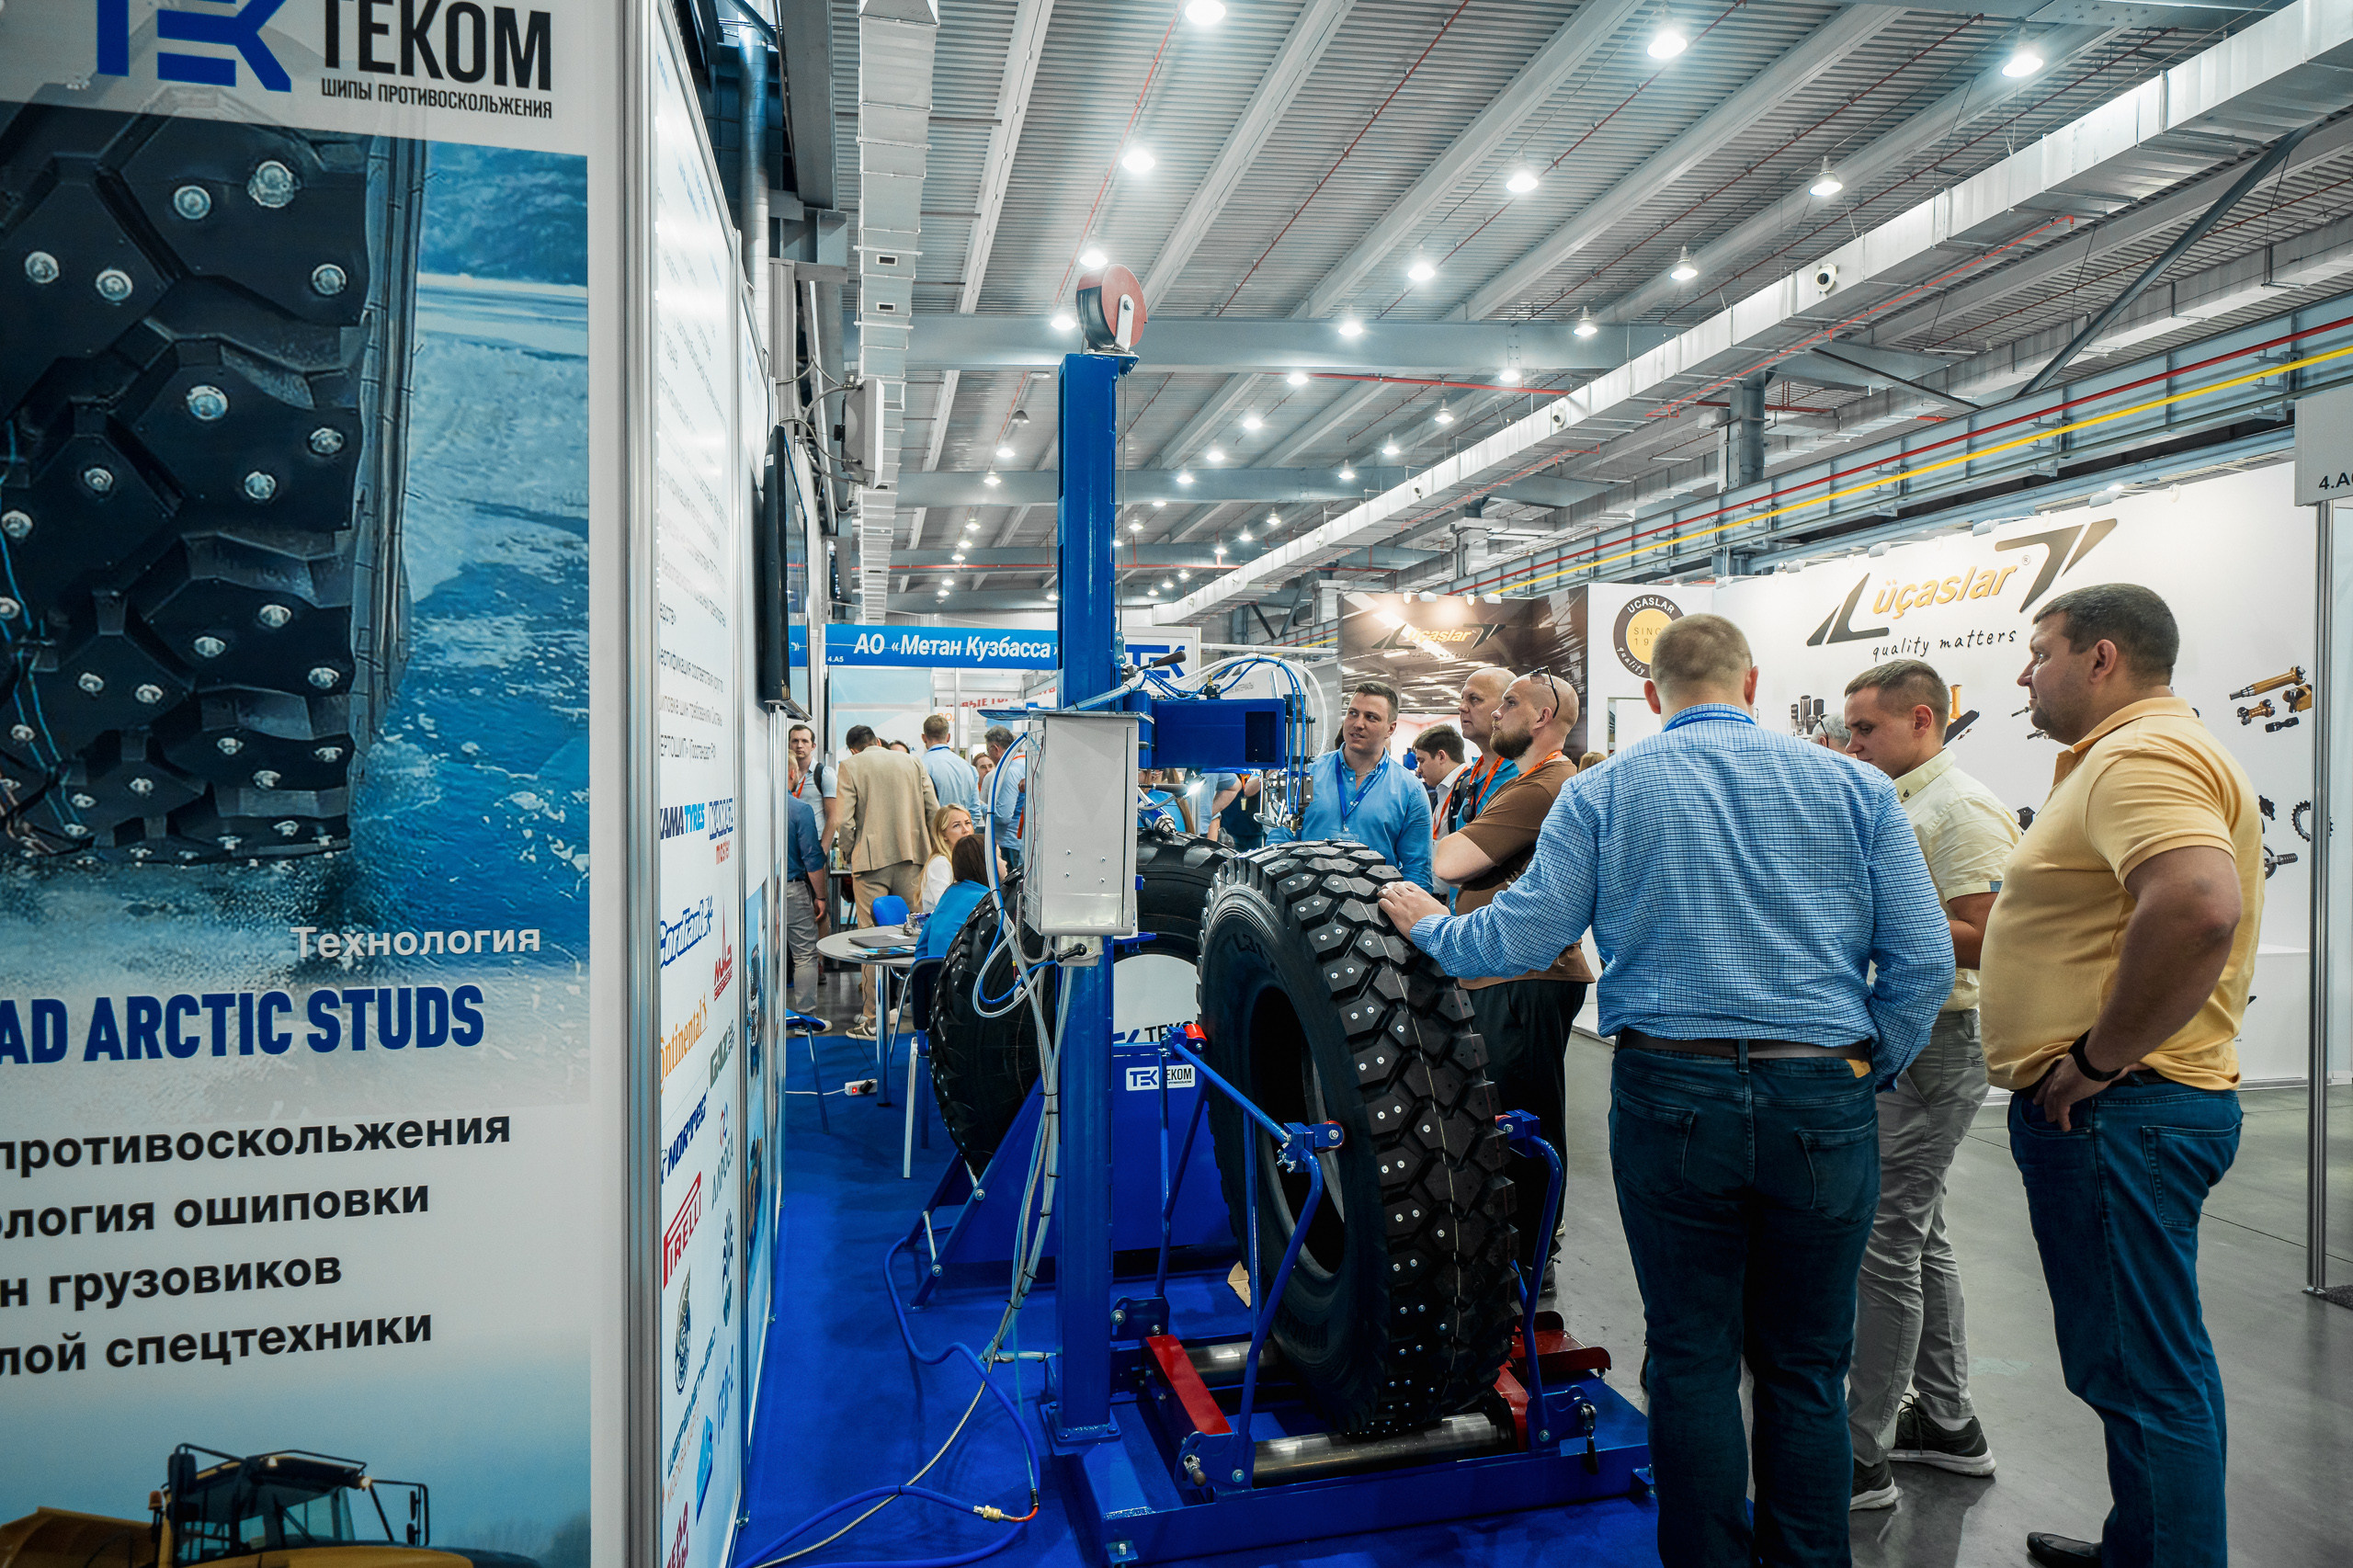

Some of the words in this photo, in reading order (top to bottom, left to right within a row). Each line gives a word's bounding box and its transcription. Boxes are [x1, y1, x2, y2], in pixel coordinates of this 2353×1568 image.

[322, 77, 372, 101] ШИПЫ
[378, 84, 552, 119] ПРОТИВОСКОЛЬЖЕНИЯ
[2319, 472, 2353, 490] 4.A
[1627, 597, 1675, 614] UCASLAR
[1872, 565, 2018, 619] üçaslar
[854, 633, 884, 654] АО
[892, 634, 961, 656] «Метан
[1633, 627, 1661, 635] SINC
[1872, 636, 1929, 662] quality
[1939, 629, 2017, 649] matters
[290, 926, 541, 959] Технология
[83, 991, 293, 1062] ARCTIC
[306, 984, 484, 1052] STUDS
[1167, 1068, 1191, 1081] ЕКОМ
[0, 1202, 154, 1239] логия
[175, 1185, 428, 1229] ошиповки
[664, 1171, 701, 1290] PIRELLI
[49, 1256, 342, 1312] грузовиков
[107, 1314, 431, 1366] спецтехники
